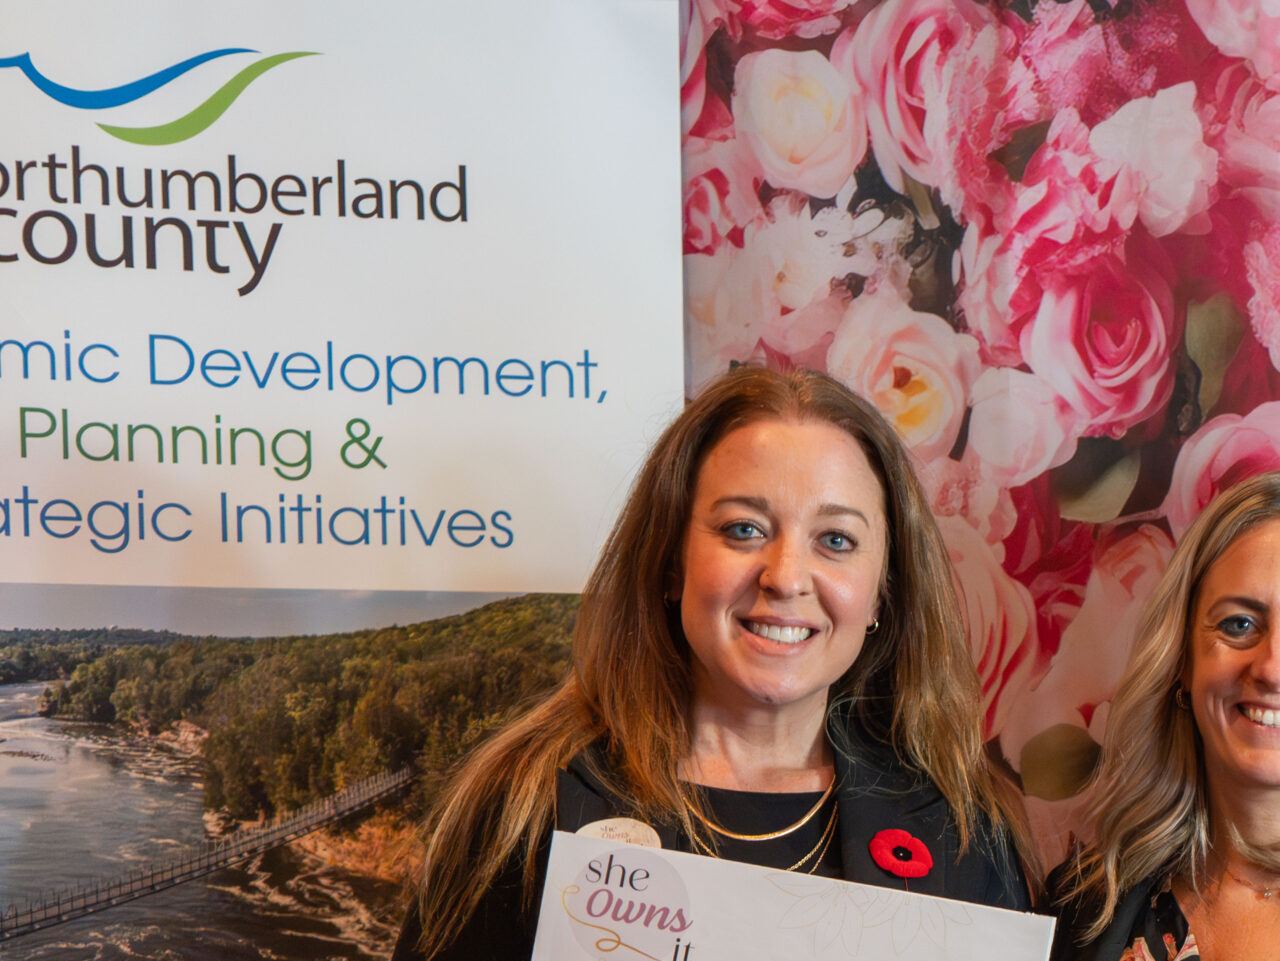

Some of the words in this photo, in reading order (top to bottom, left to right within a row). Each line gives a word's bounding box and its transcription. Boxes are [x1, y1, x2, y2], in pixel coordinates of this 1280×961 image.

[0, 145, 469, 222] rthumberland
[148, 333, 608, 405] Development,
[19, 406, 313, 481] Planning
[340, 417, 388, 470] &
[220, 492, 514, 549] Initiatives
[585, 854, 650, 892] she
[586, 888, 694, 933] Owns
